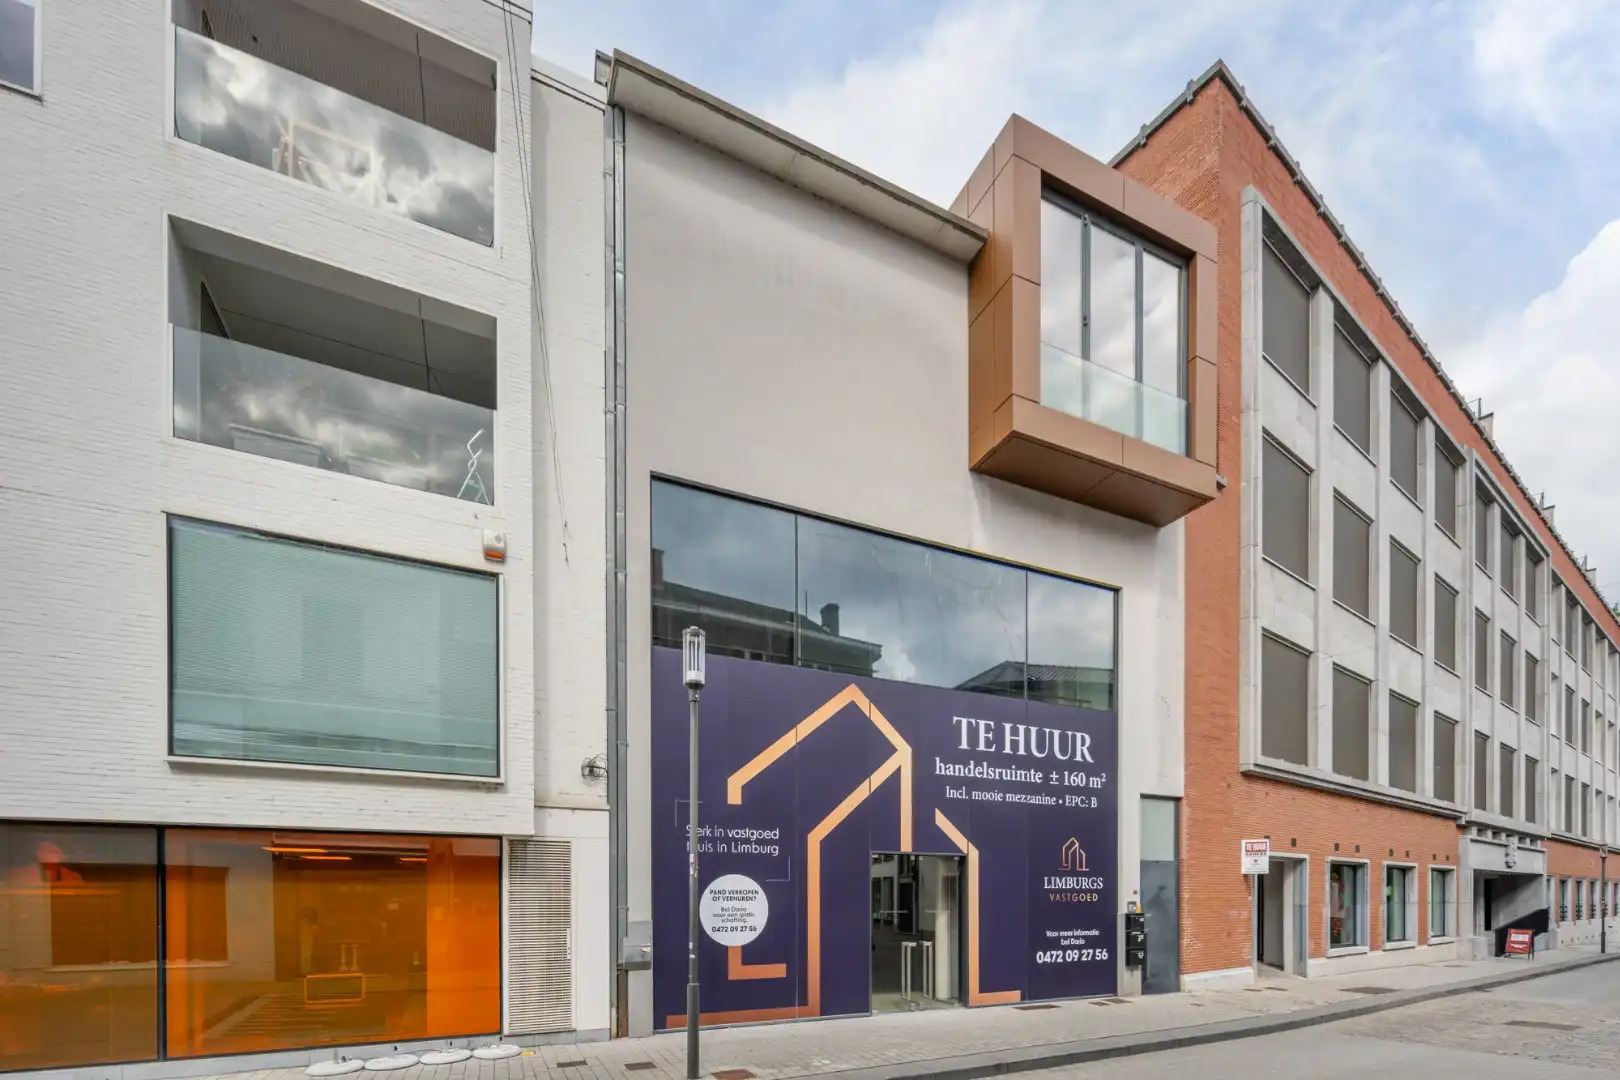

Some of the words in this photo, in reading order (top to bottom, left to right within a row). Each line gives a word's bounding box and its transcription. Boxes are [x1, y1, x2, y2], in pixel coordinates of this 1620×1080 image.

[953, 716, 996, 752] TE
[1002, 722, 1094, 763] HUUR
[935, 757, 1043, 783] handelsruimte
[1063, 772, 1085, 787] 160
[946, 786, 968, 798] Incl.
[972, 790, 1003, 801] mooie
[1006, 793, 1056, 805] mezzanine
[1065, 795, 1089, 807] EPC:
[1091, 797, 1098, 808] B
[686, 824, 712, 838] Serk
[715, 825, 724, 838] in
[727, 828, 779, 840] vastgoed
[686, 840, 713, 853] tuis
[717, 841, 727, 852] in
[731, 841, 779, 857] Limburg
[1043, 876, 1104, 890] LIMBURGS
[1049, 893, 1099, 902] VASTGOED
[1036, 950, 1063, 964] 0472
[1065, 950, 1080, 962] 09
[1081, 949, 1094, 962] 27
[1095, 948, 1109, 961] 56
